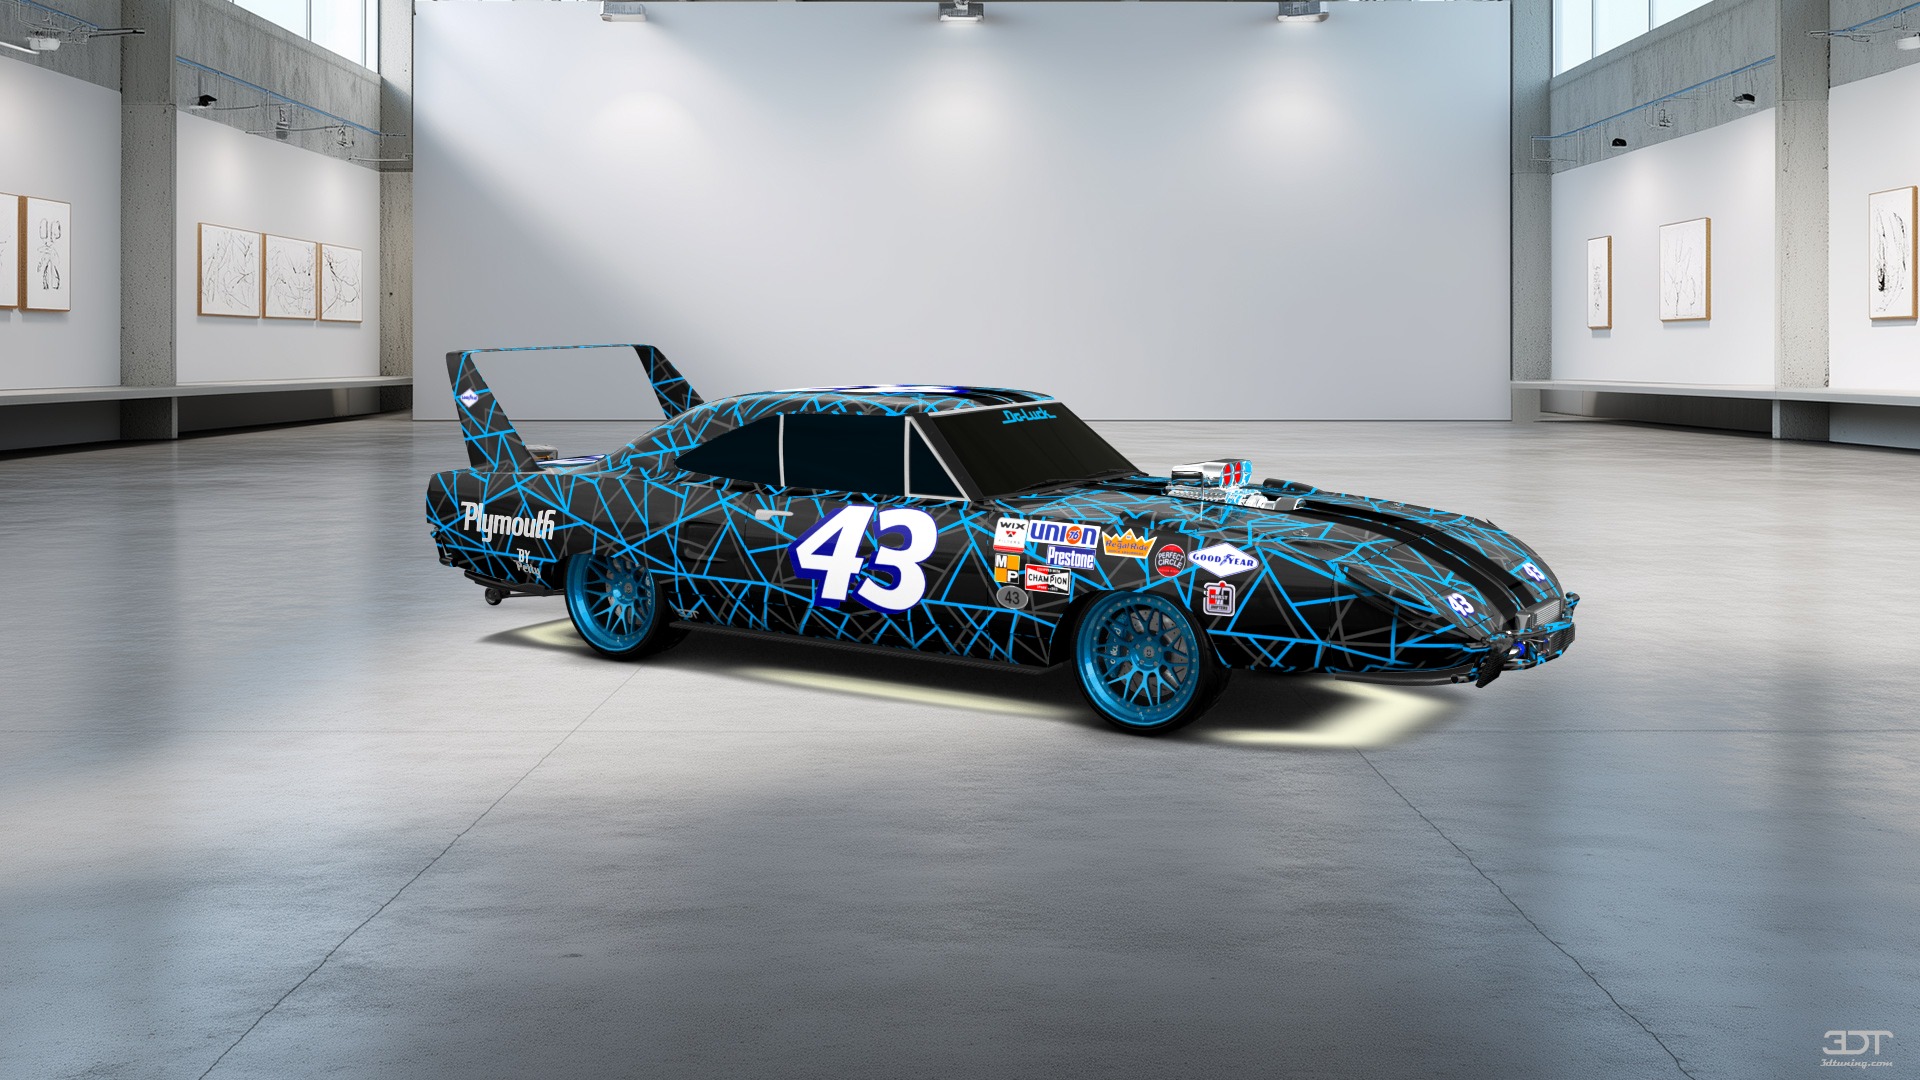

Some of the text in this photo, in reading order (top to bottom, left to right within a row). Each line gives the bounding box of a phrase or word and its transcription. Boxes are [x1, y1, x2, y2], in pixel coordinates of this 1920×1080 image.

[461, 501, 556, 542] Plymouth
[1000, 521, 1026, 530] WIX
[1068, 530, 1080, 540] 76
[516, 548, 530, 564] BY
[787, 504, 939, 614] 43
[1048, 546, 1095, 568] Prestone
[1157, 558, 1183, 569] CIRCLE
[1158, 551, 1184, 561] PERFECT
[1028, 573, 1068, 585] CHAMPION
[1521, 562, 1547, 583] 43
[1004, 590, 1020, 605] 43
[1447, 592, 1475, 618] 43
